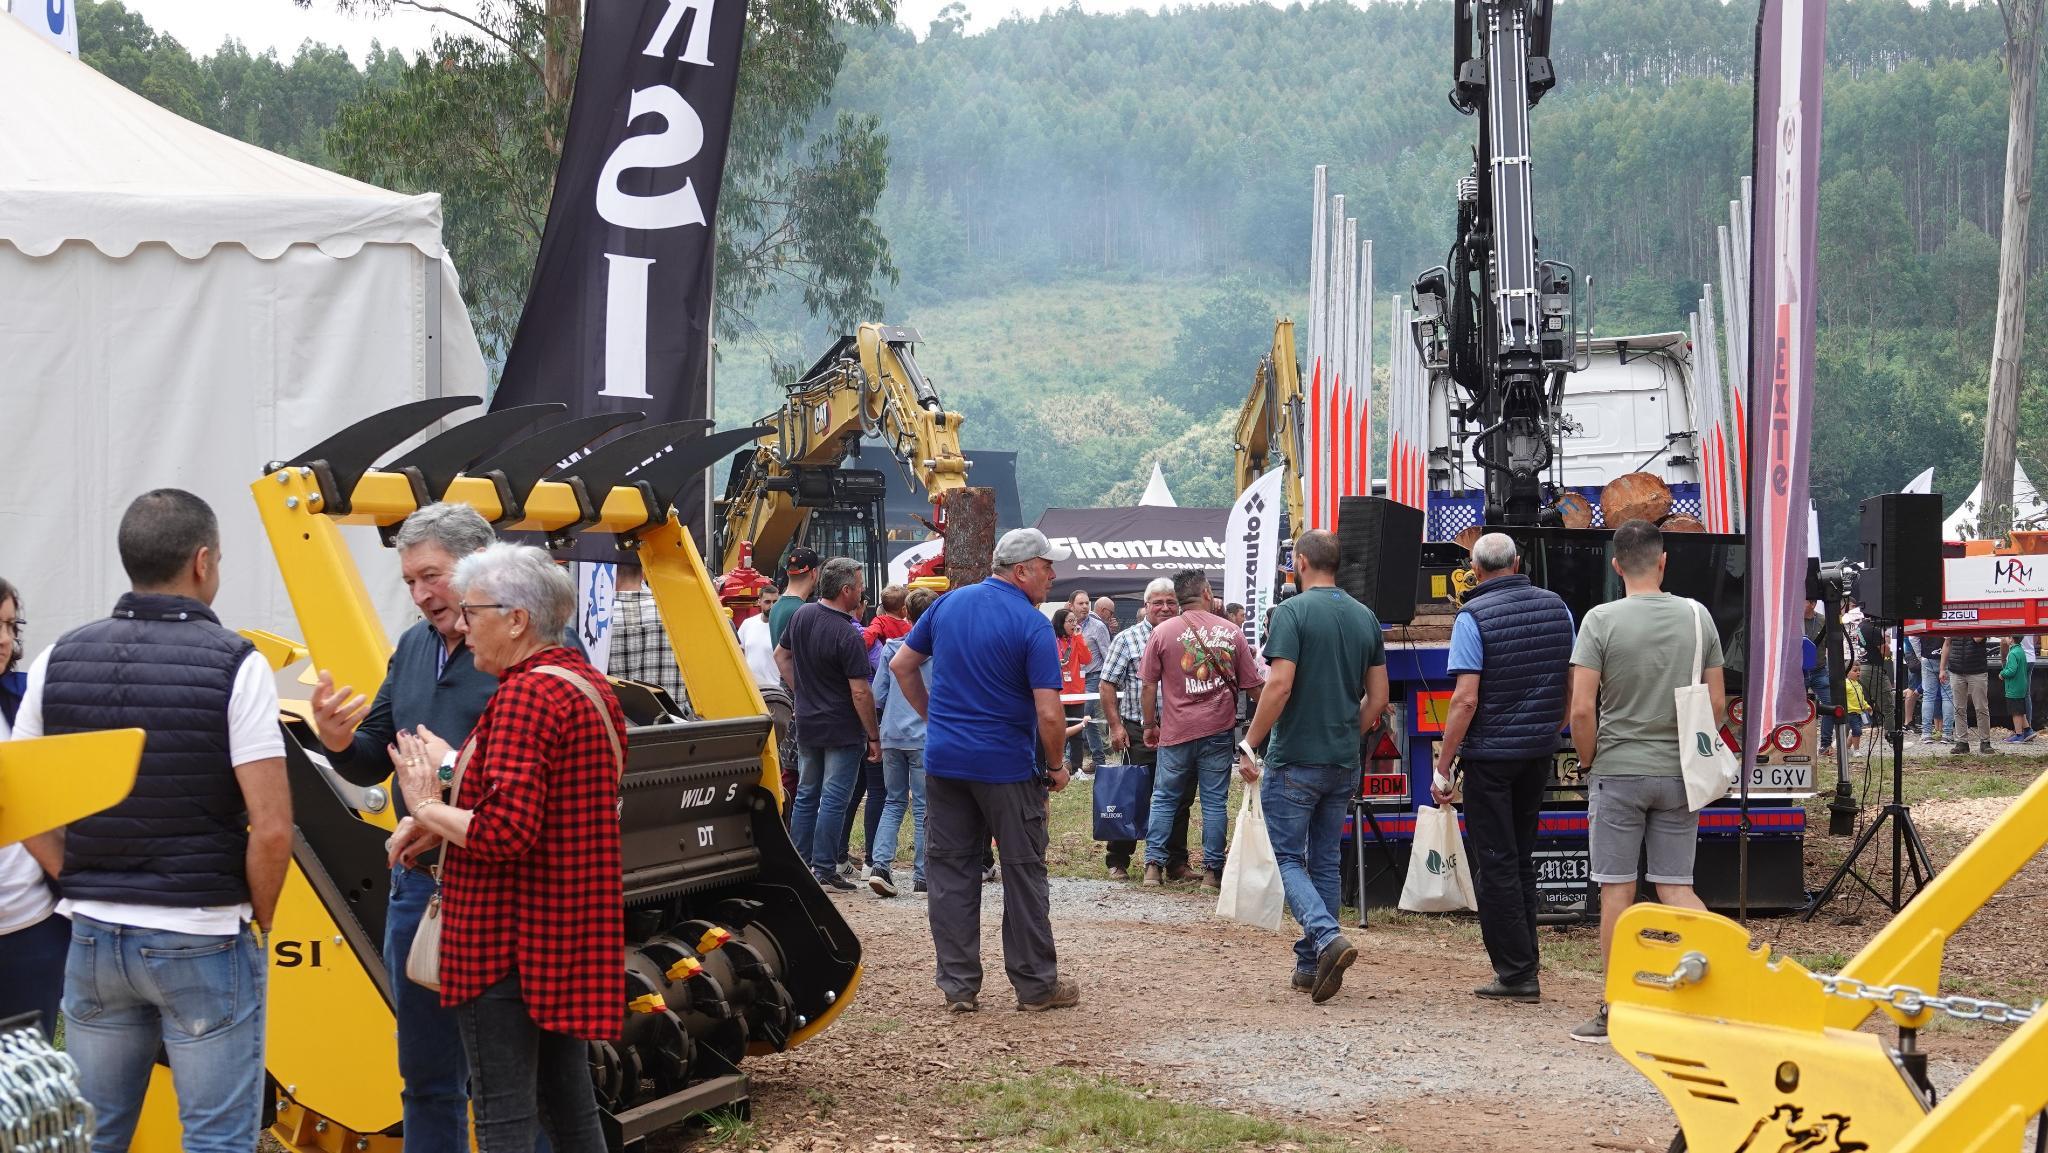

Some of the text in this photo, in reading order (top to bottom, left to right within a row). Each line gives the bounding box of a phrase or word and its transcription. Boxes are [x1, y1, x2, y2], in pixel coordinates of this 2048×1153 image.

[815, 401, 828, 434] CAT
[1048, 536, 1226, 559] Finanzaut
[1152, 562, 1226, 570] COMPAN
[1995, 559, 2033, 586] MRM
[1243, 516, 1261, 645] inanzauto
[1771, 769, 1806, 785] GXV
[680, 783, 738, 809] WILD S
[697, 825, 714, 847] DT
